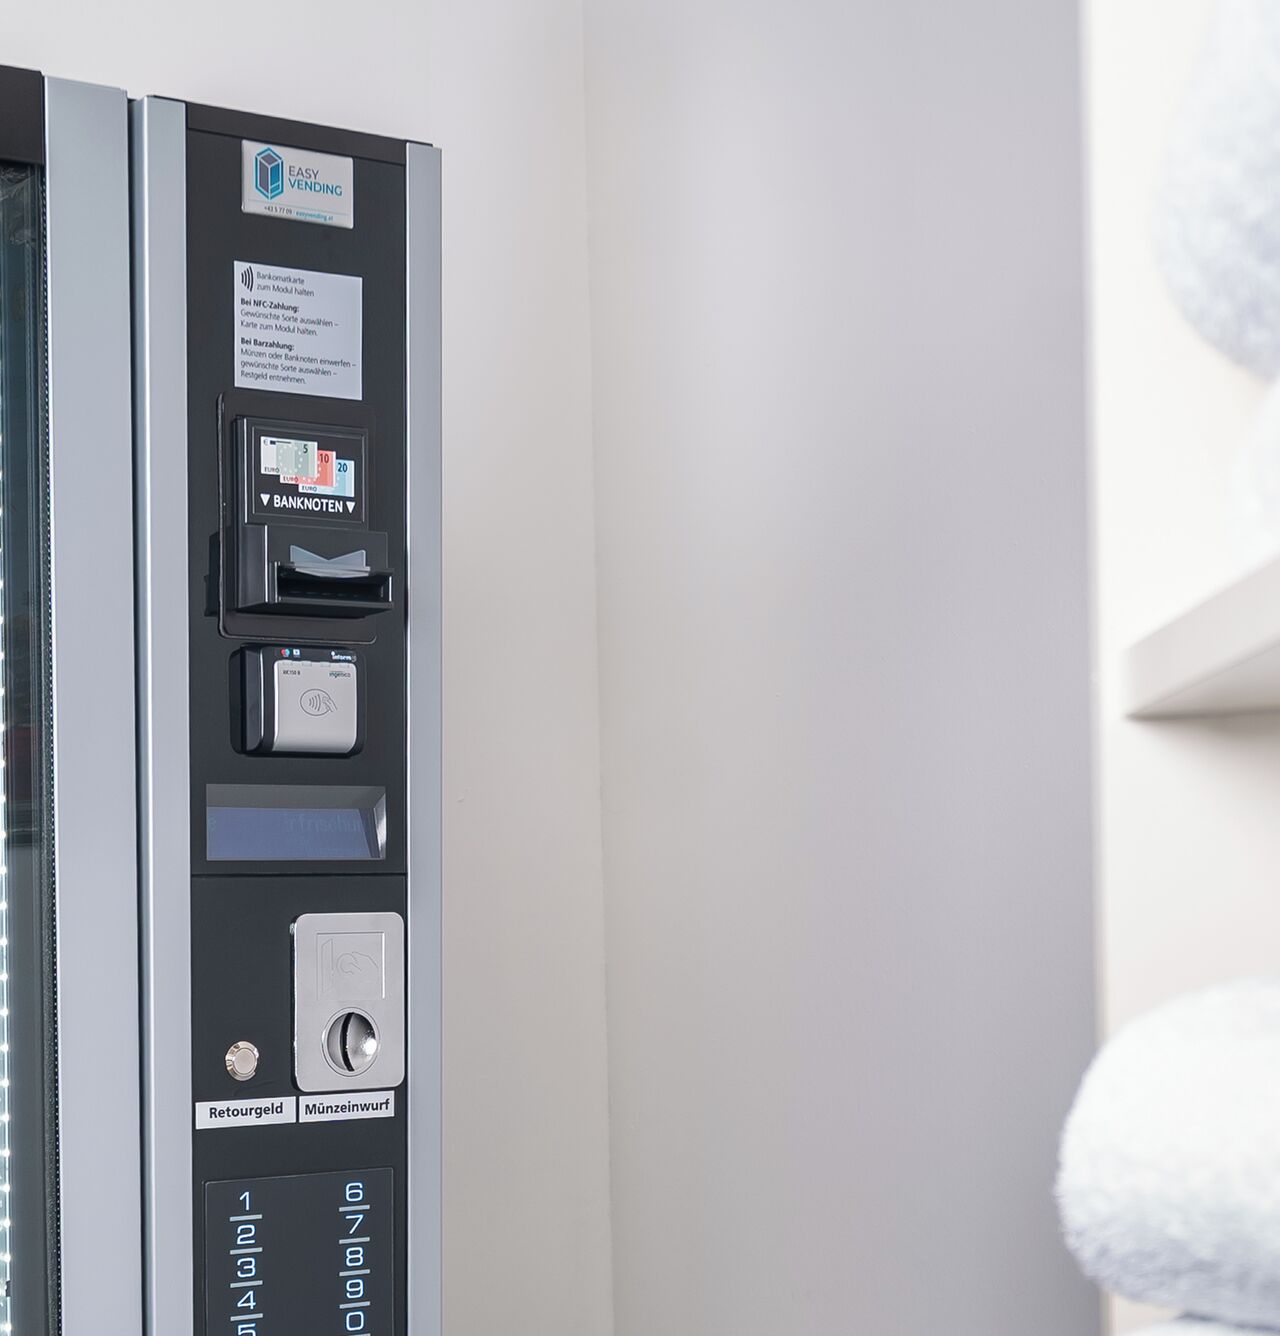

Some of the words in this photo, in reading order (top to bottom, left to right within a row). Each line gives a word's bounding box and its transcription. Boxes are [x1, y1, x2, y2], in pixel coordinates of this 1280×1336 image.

[288, 165, 320, 180] EASY
[288, 177, 343, 197] VENDING
[257, 271, 305, 285] Bankomatkarte
[272, 284, 293, 295] Modul
[241, 298, 252, 306] Bei
[253, 299, 300, 314] NFC-Zahlung:
[241, 309, 281, 321] Gewünschte
[282, 314, 299, 323] Sorte
[300, 317, 333, 328] auswählen
[241, 320, 258, 329] Karte
[275, 323, 295, 334] Modul
[241, 337, 252, 346] Bei
[253, 338, 295, 352] Barzahlung:
[241, 348, 267, 359] Münzen
[268, 352, 283, 360] oder
[284, 353, 318, 364] Banknoten
[319, 358, 351, 369] einwerfen
[241, 360, 279, 371] gewünschte
[280, 363, 297, 372] Sorte
[298, 366, 332, 377] auswählen
[241, 370, 268, 381] Restgeld
[269, 374, 306, 384] entnehmen.
[319, 453, 330, 463] 10
[337, 462, 348, 473] 20
[301, 485, 317, 493] EURO
[273, 494, 344, 514] BANKNOTEN
[209, 1102, 284, 1120] Retourgeld
[304, 1098, 390, 1116] Münzeinwurf
[239, 1191, 251, 1210] 1
[345, 1182, 363, 1202] 6
[237, 1224, 256, 1245] 2
[345, 1215, 364, 1235] 7
[237, 1257, 256, 1278] 3
[346, 1247, 364, 1267] 8
[237, 1290, 256, 1310] 4
[346, 1279, 364, 1299] 9
[346, 1311, 364, 1331] 0
